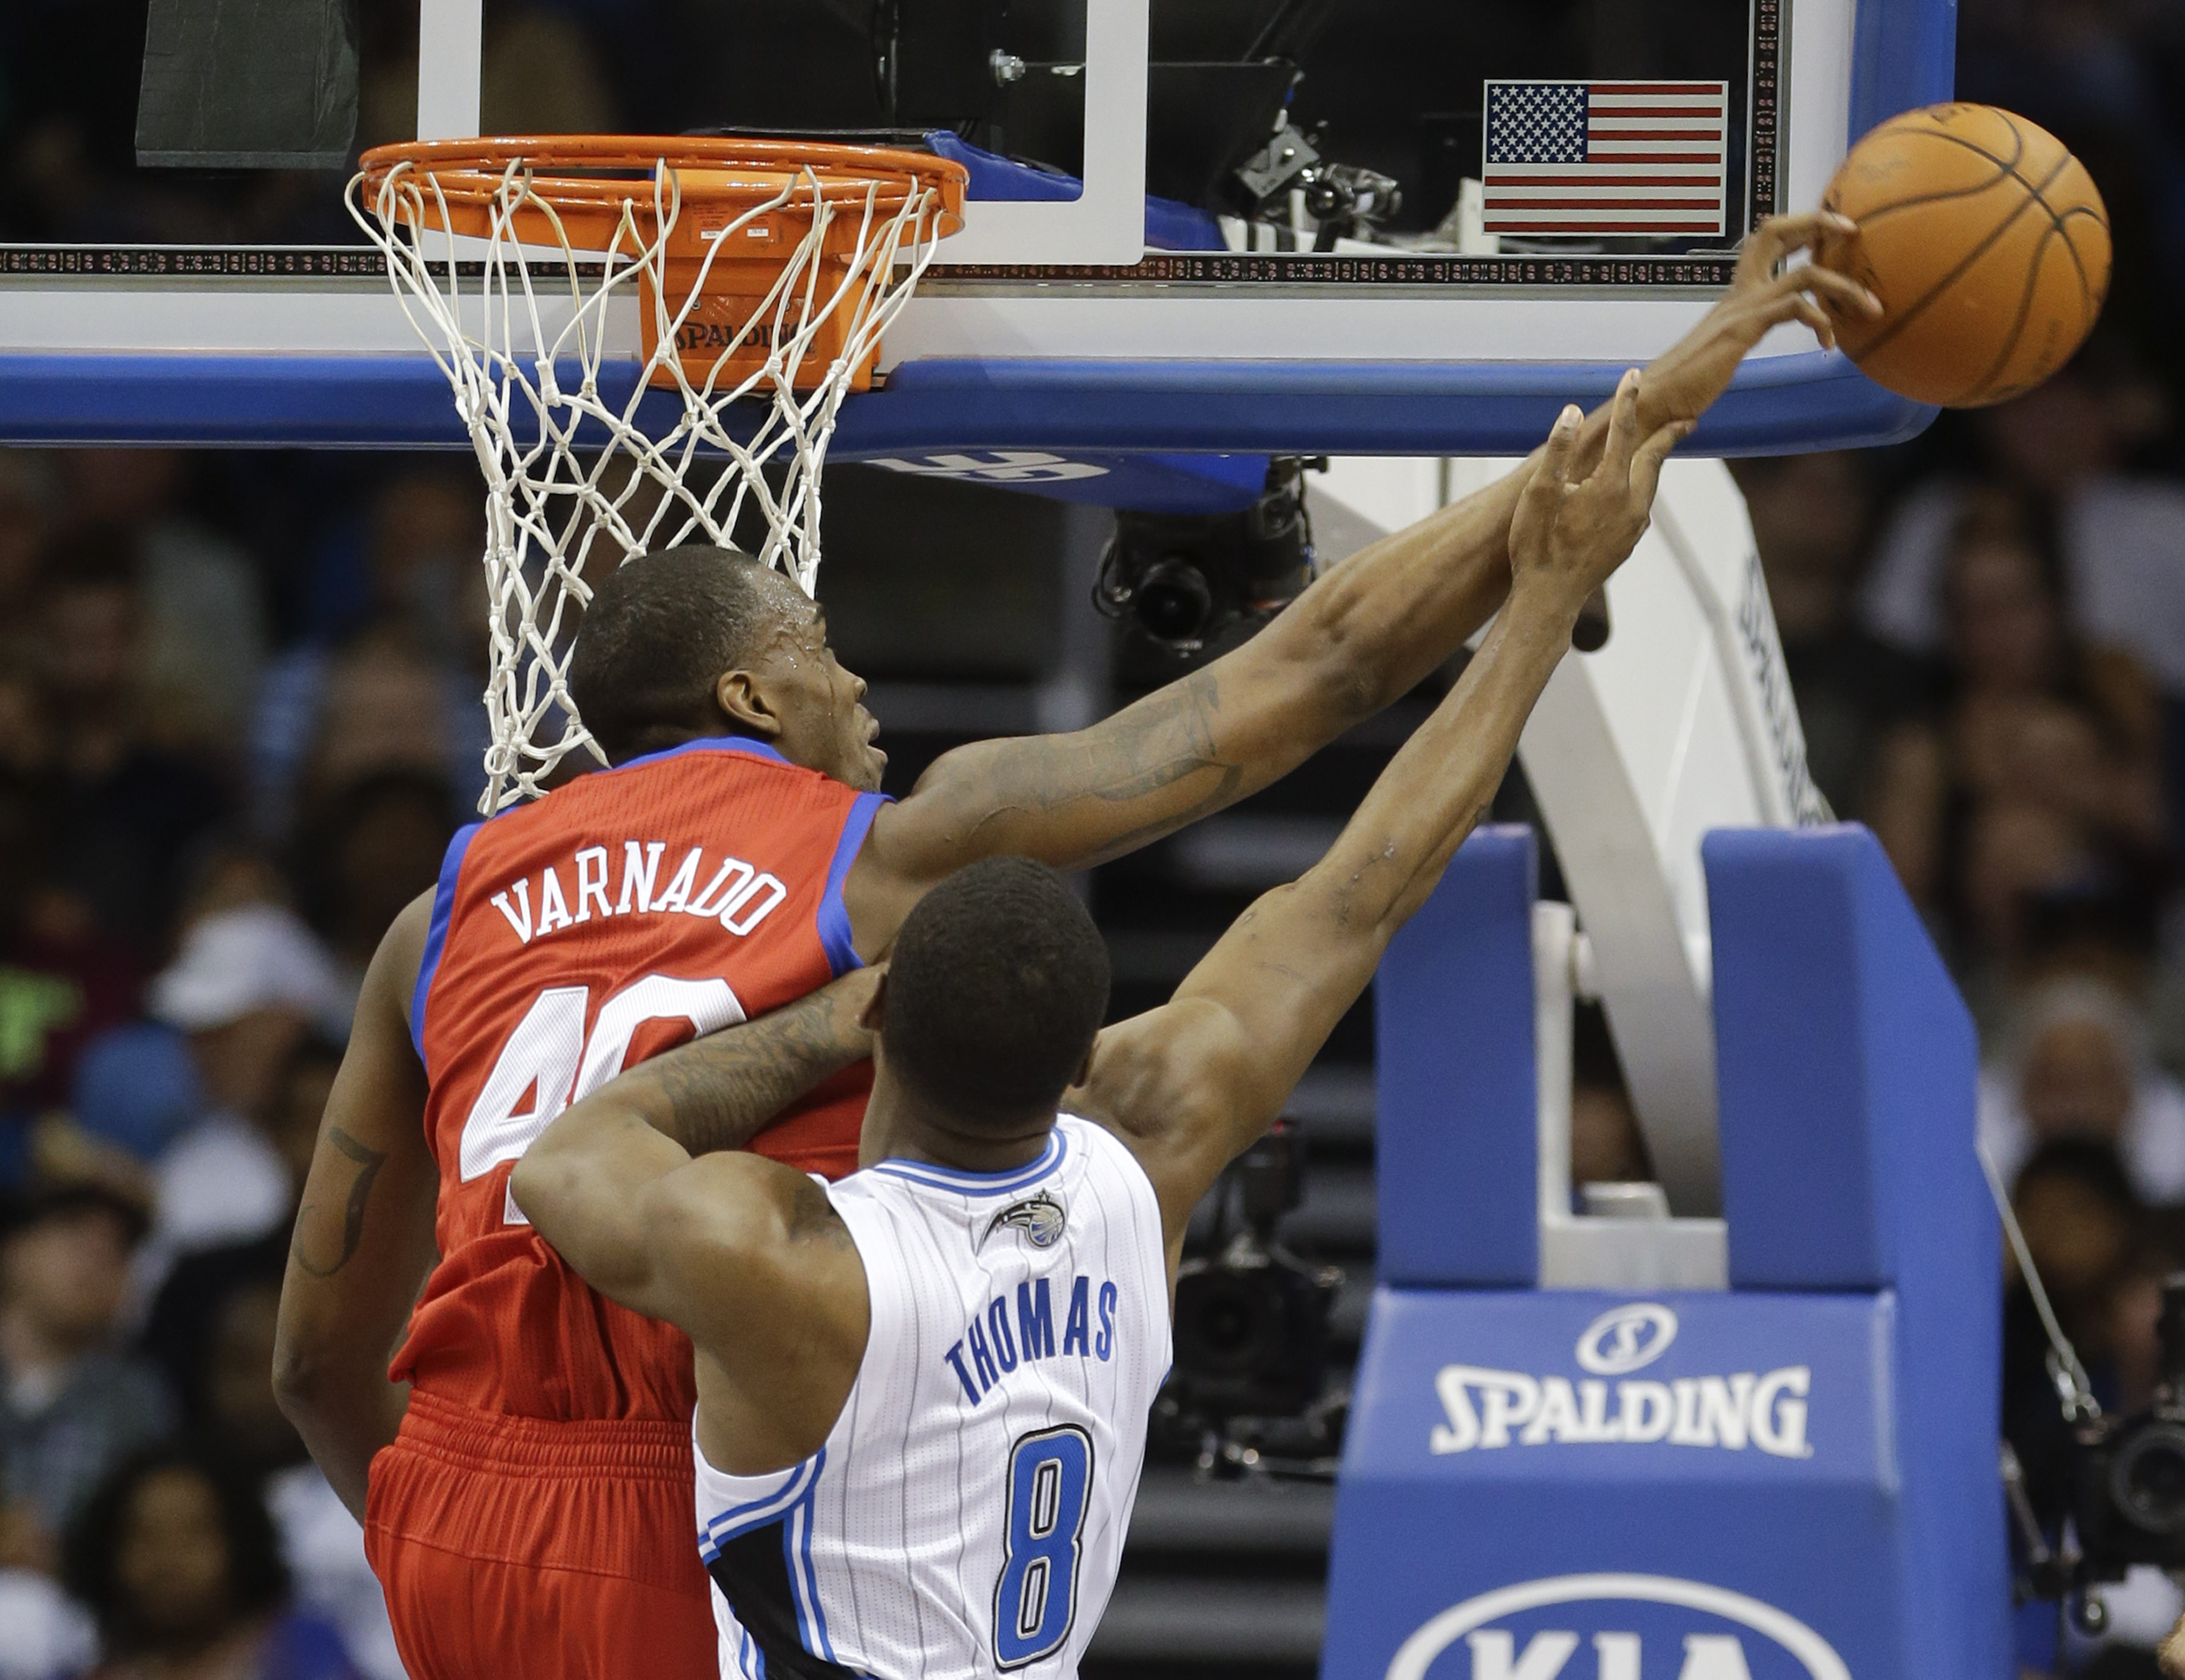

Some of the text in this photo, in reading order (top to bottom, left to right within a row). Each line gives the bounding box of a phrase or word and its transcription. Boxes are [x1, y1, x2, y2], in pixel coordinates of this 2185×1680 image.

[490, 839, 787, 945] VARNADO
[945, 1275, 1118, 1407] THOMAS
[1429, 1363, 1812, 1457] SPALDING
[992, 1423, 1095, 1673] 8
